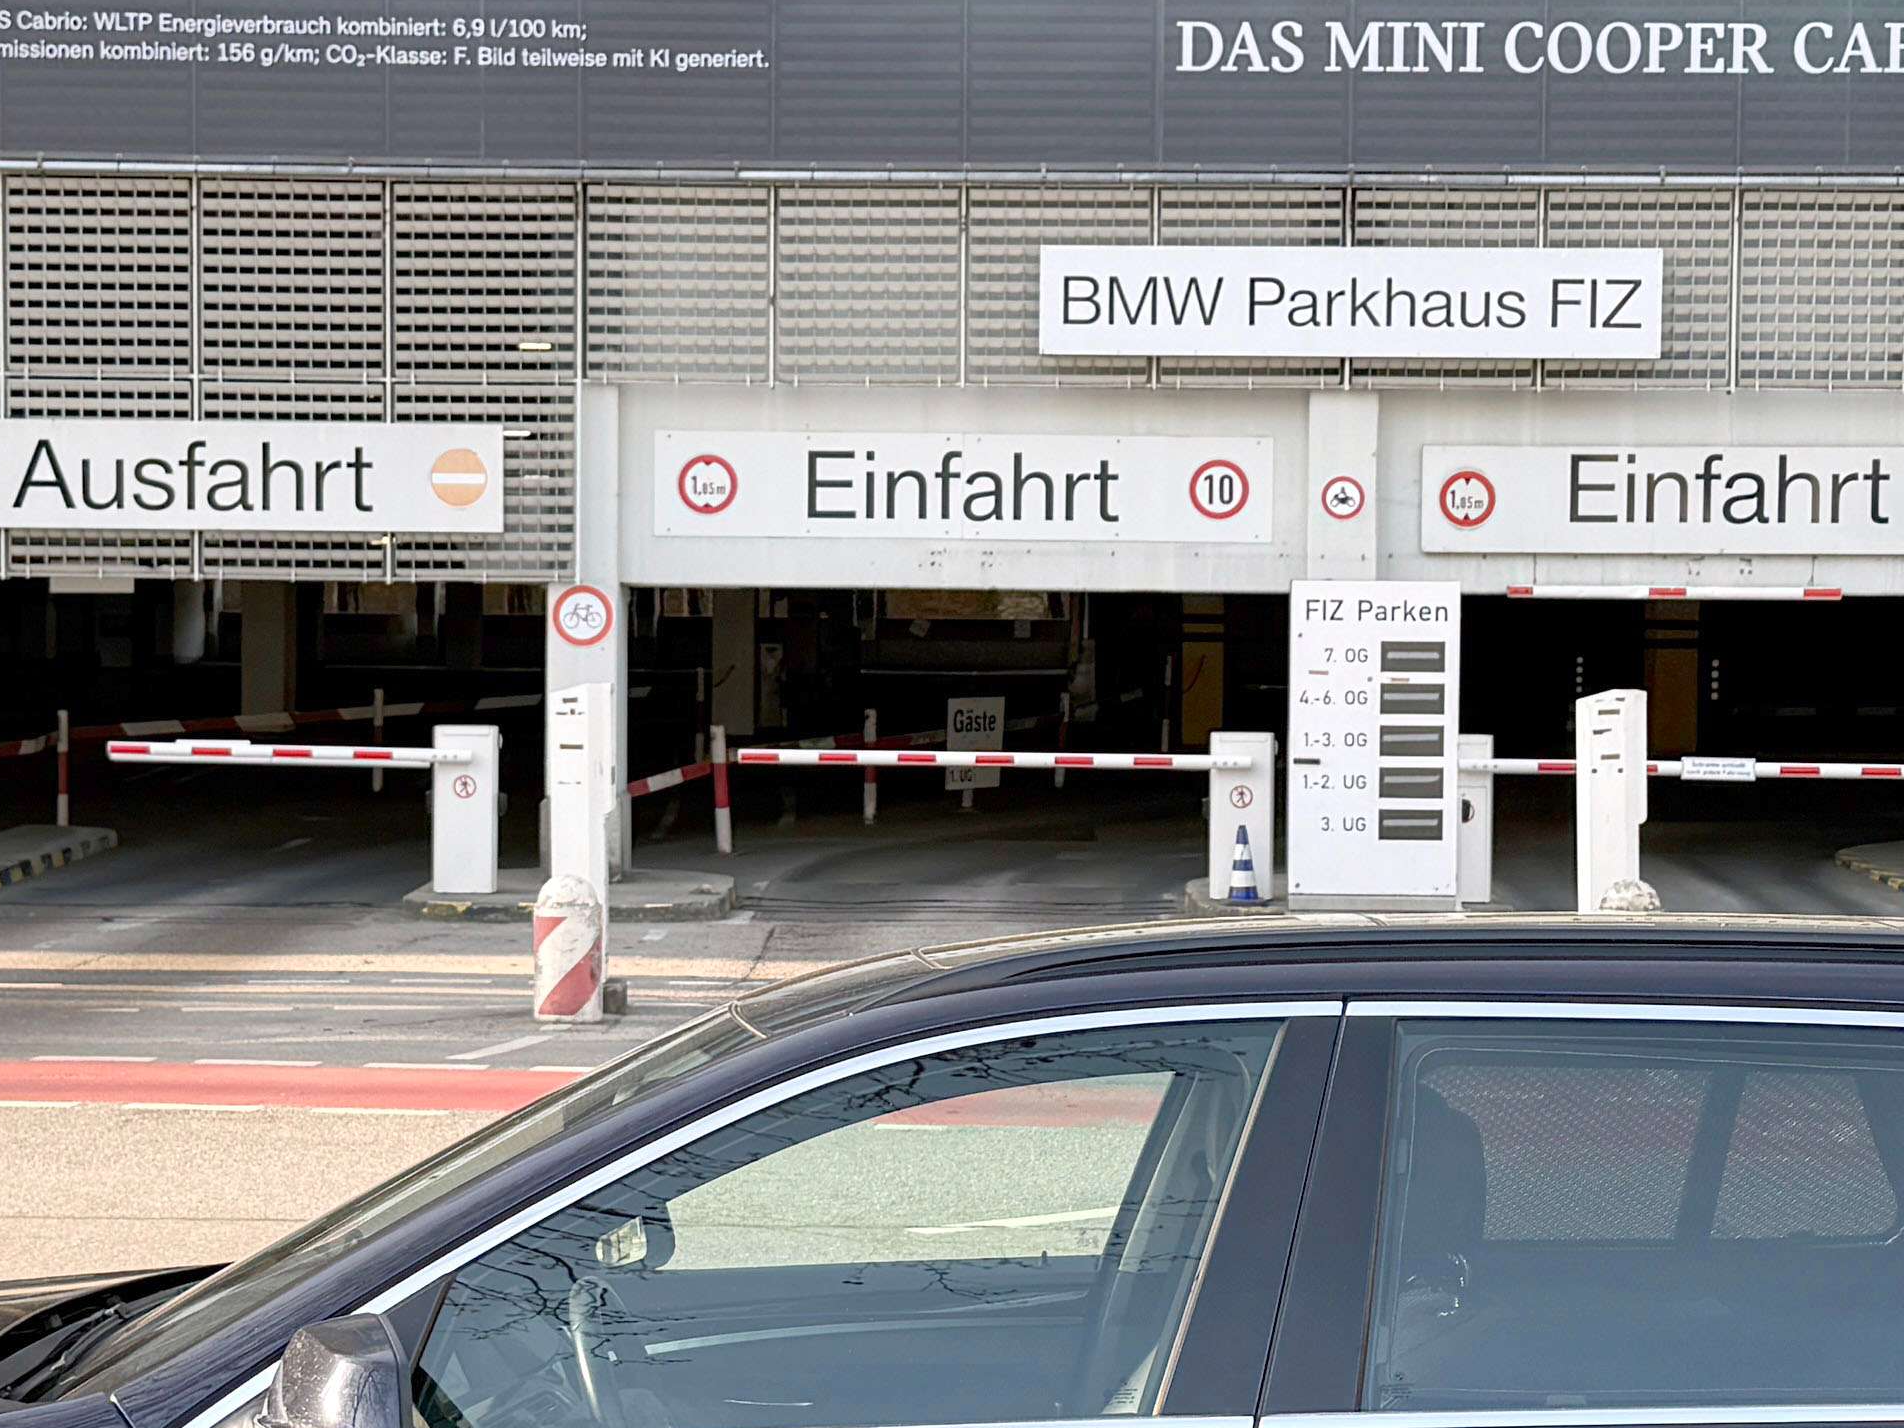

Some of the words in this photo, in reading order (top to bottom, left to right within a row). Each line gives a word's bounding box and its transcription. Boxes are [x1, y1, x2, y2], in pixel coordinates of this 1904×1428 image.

[17, 11, 87, 30] Cabrio:
[93, 12, 152, 31] WLTP
[159, 13, 330, 37] Energieverbrauch
[337, 17, 446, 36] kombiniert:
[453, 18, 484, 39] 6,9
[491, 19, 545, 37] l/100
[552, 20, 586, 40] km;
[100, 36, 212, 61] kombiniert:
[218, 43, 255, 62] 156
[261, 43, 319, 66] g/km;
[455, 47, 470, 65] F.
[478, 46, 515, 65] Bild
[522, 48, 607, 67] teilweise
[613, 49, 643, 67] mit
[675, 49, 769, 71] generiert.
[1176, 21, 1303, 72] DAS
[1325, 22, 1485, 72] MINI
[1505, 22, 1774, 73] COOPER
[1063, 276, 1223, 325] BMW
[1249, 277, 1525, 328] Parkhaus
[1551, 279, 1641, 328] FIZ
[13, 440, 373, 512] Ausfahrt
[808, 451, 1119, 522] Einfahrt
[1204, 474, 1234, 507] 10
[1570, 454, 1890, 524] Einfahrt
[1307, 600, 1343, 620] FIZ
[1358, 600, 1447, 621] Parken
[1324, 647, 1337, 663] 7.
[1345, 648, 1368, 663] OG
[1299, 689, 1336, 705] 4.-6.
[1345, 691, 1368, 705] OG
[954, 709, 996, 732] Gäste
[1303, 732, 1335, 747] 1.-3.
[1344, 733, 1367, 747] OG
[1303, 774, 1335, 790] 1.-2.
[1344, 775, 1366, 789] UG
[1321, 816, 1335, 832] 3.
[1343, 817, 1366, 831] UG
